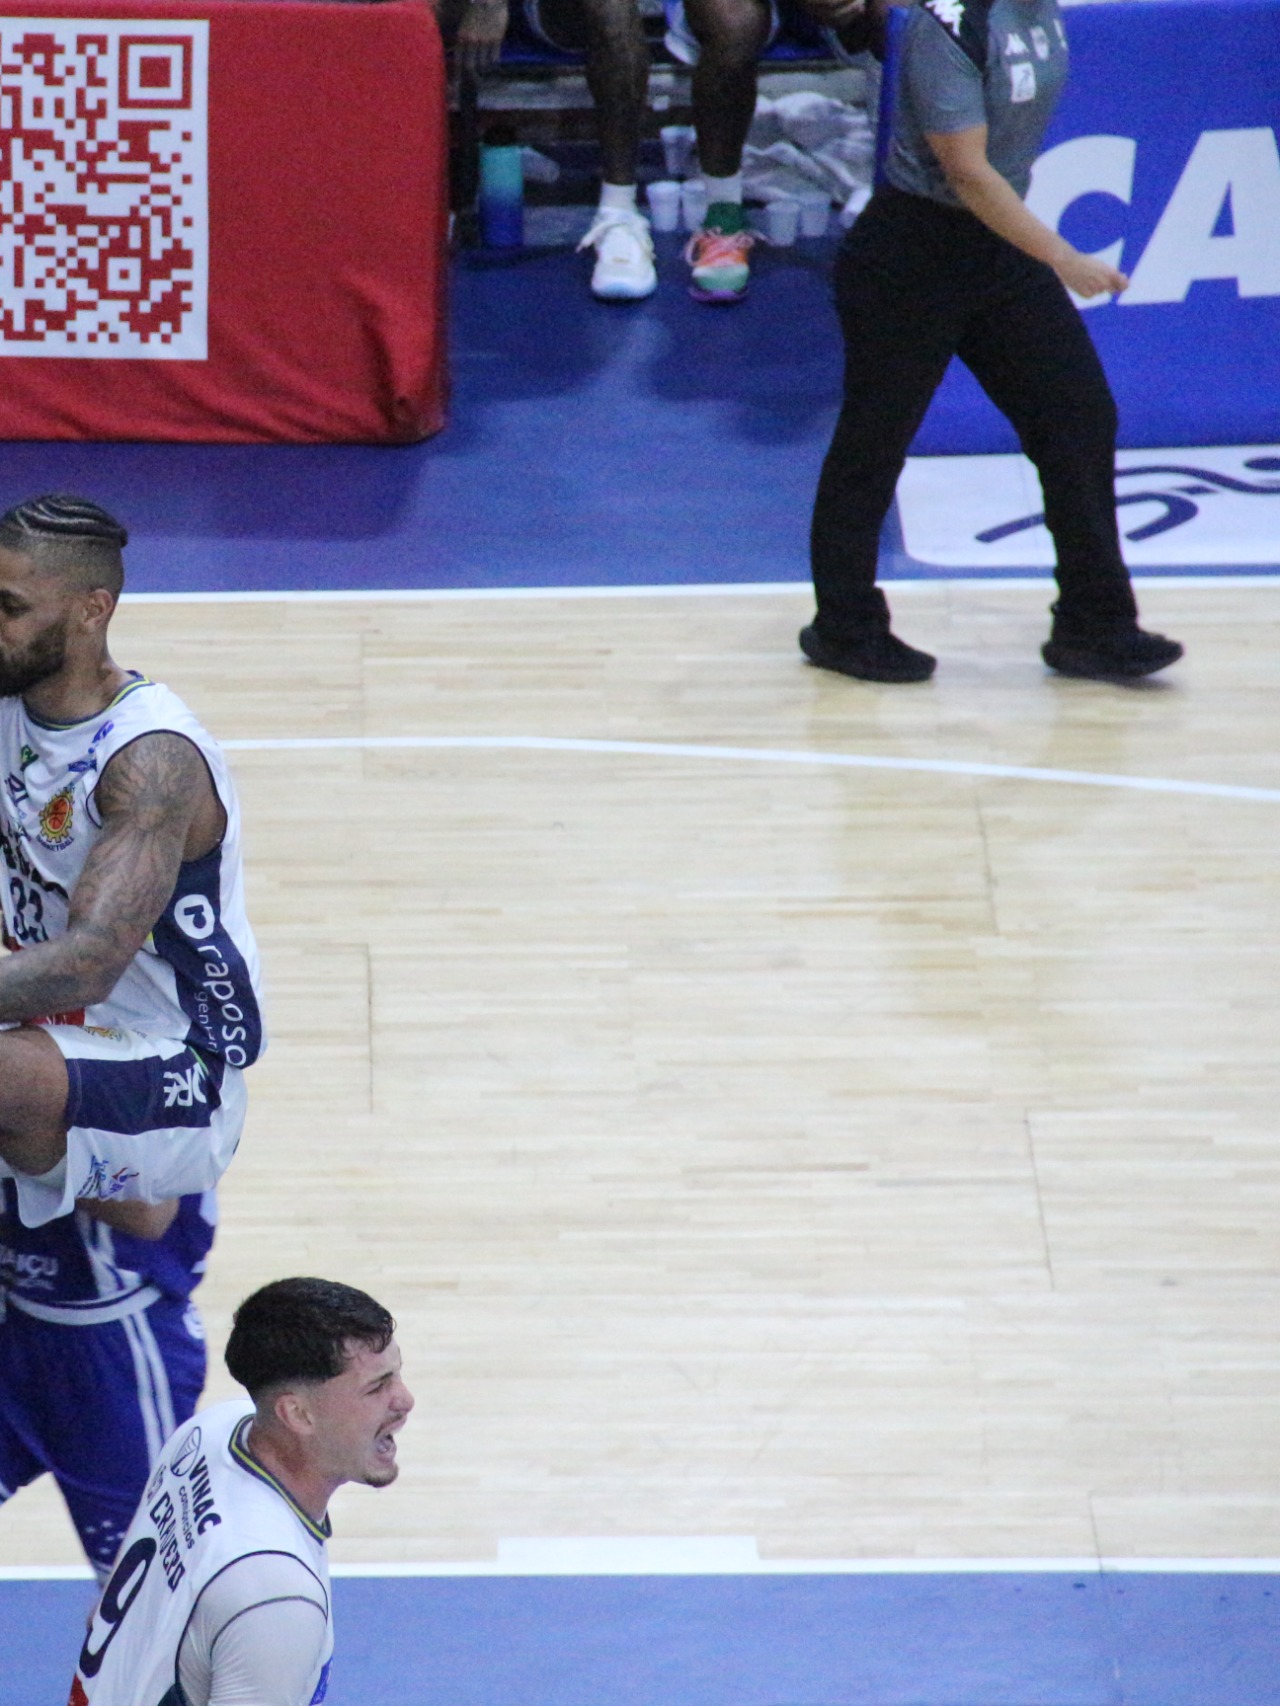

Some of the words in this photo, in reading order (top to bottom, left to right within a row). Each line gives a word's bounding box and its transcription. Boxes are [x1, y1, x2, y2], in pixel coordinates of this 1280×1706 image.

[9, 876, 49, 943] 33
[198, 946, 247, 1067] raposo
[188, 1455, 223, 1535] VINAC
[79, 1537, 157, 1679] 9
